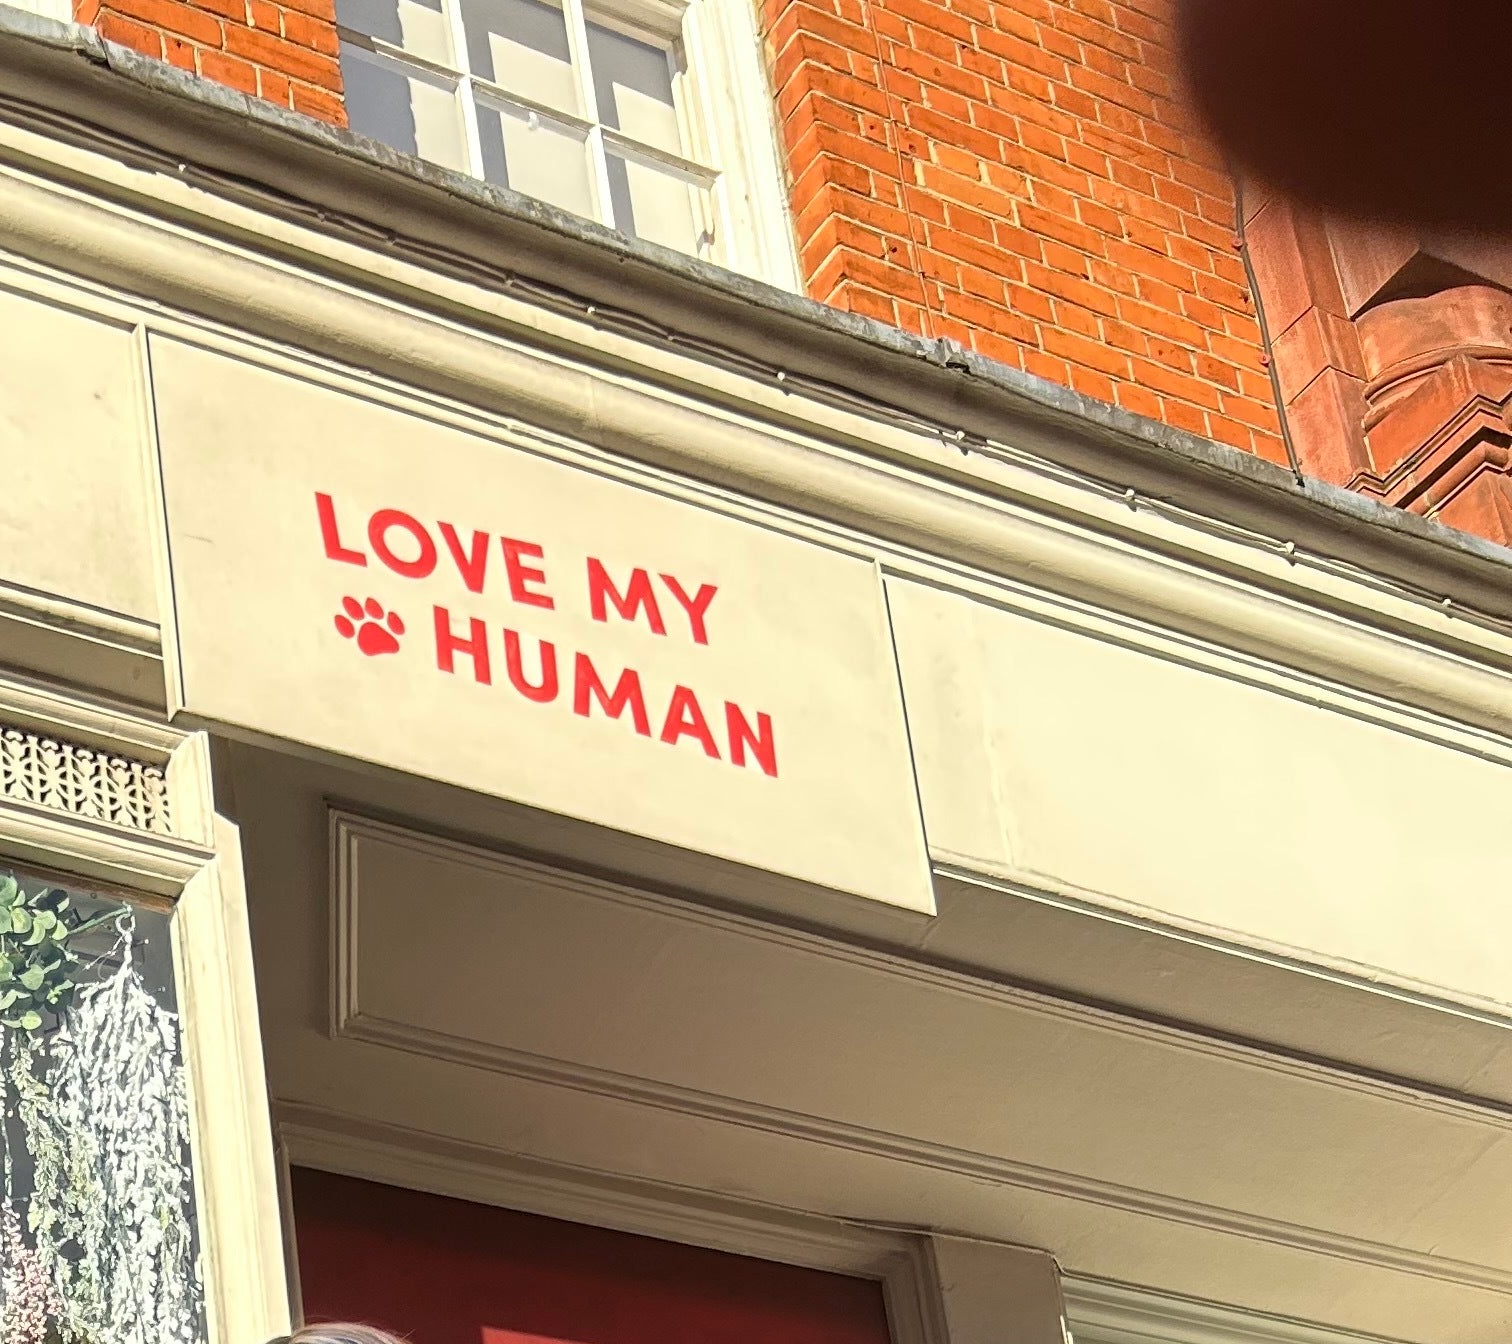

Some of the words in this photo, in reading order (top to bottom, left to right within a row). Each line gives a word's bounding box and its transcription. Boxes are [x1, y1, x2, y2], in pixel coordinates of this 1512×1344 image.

[314, 491, 555, 612] LOVE
[586, 555, 718, 646] MY
[433, 604, 778, 779] HUMAN
